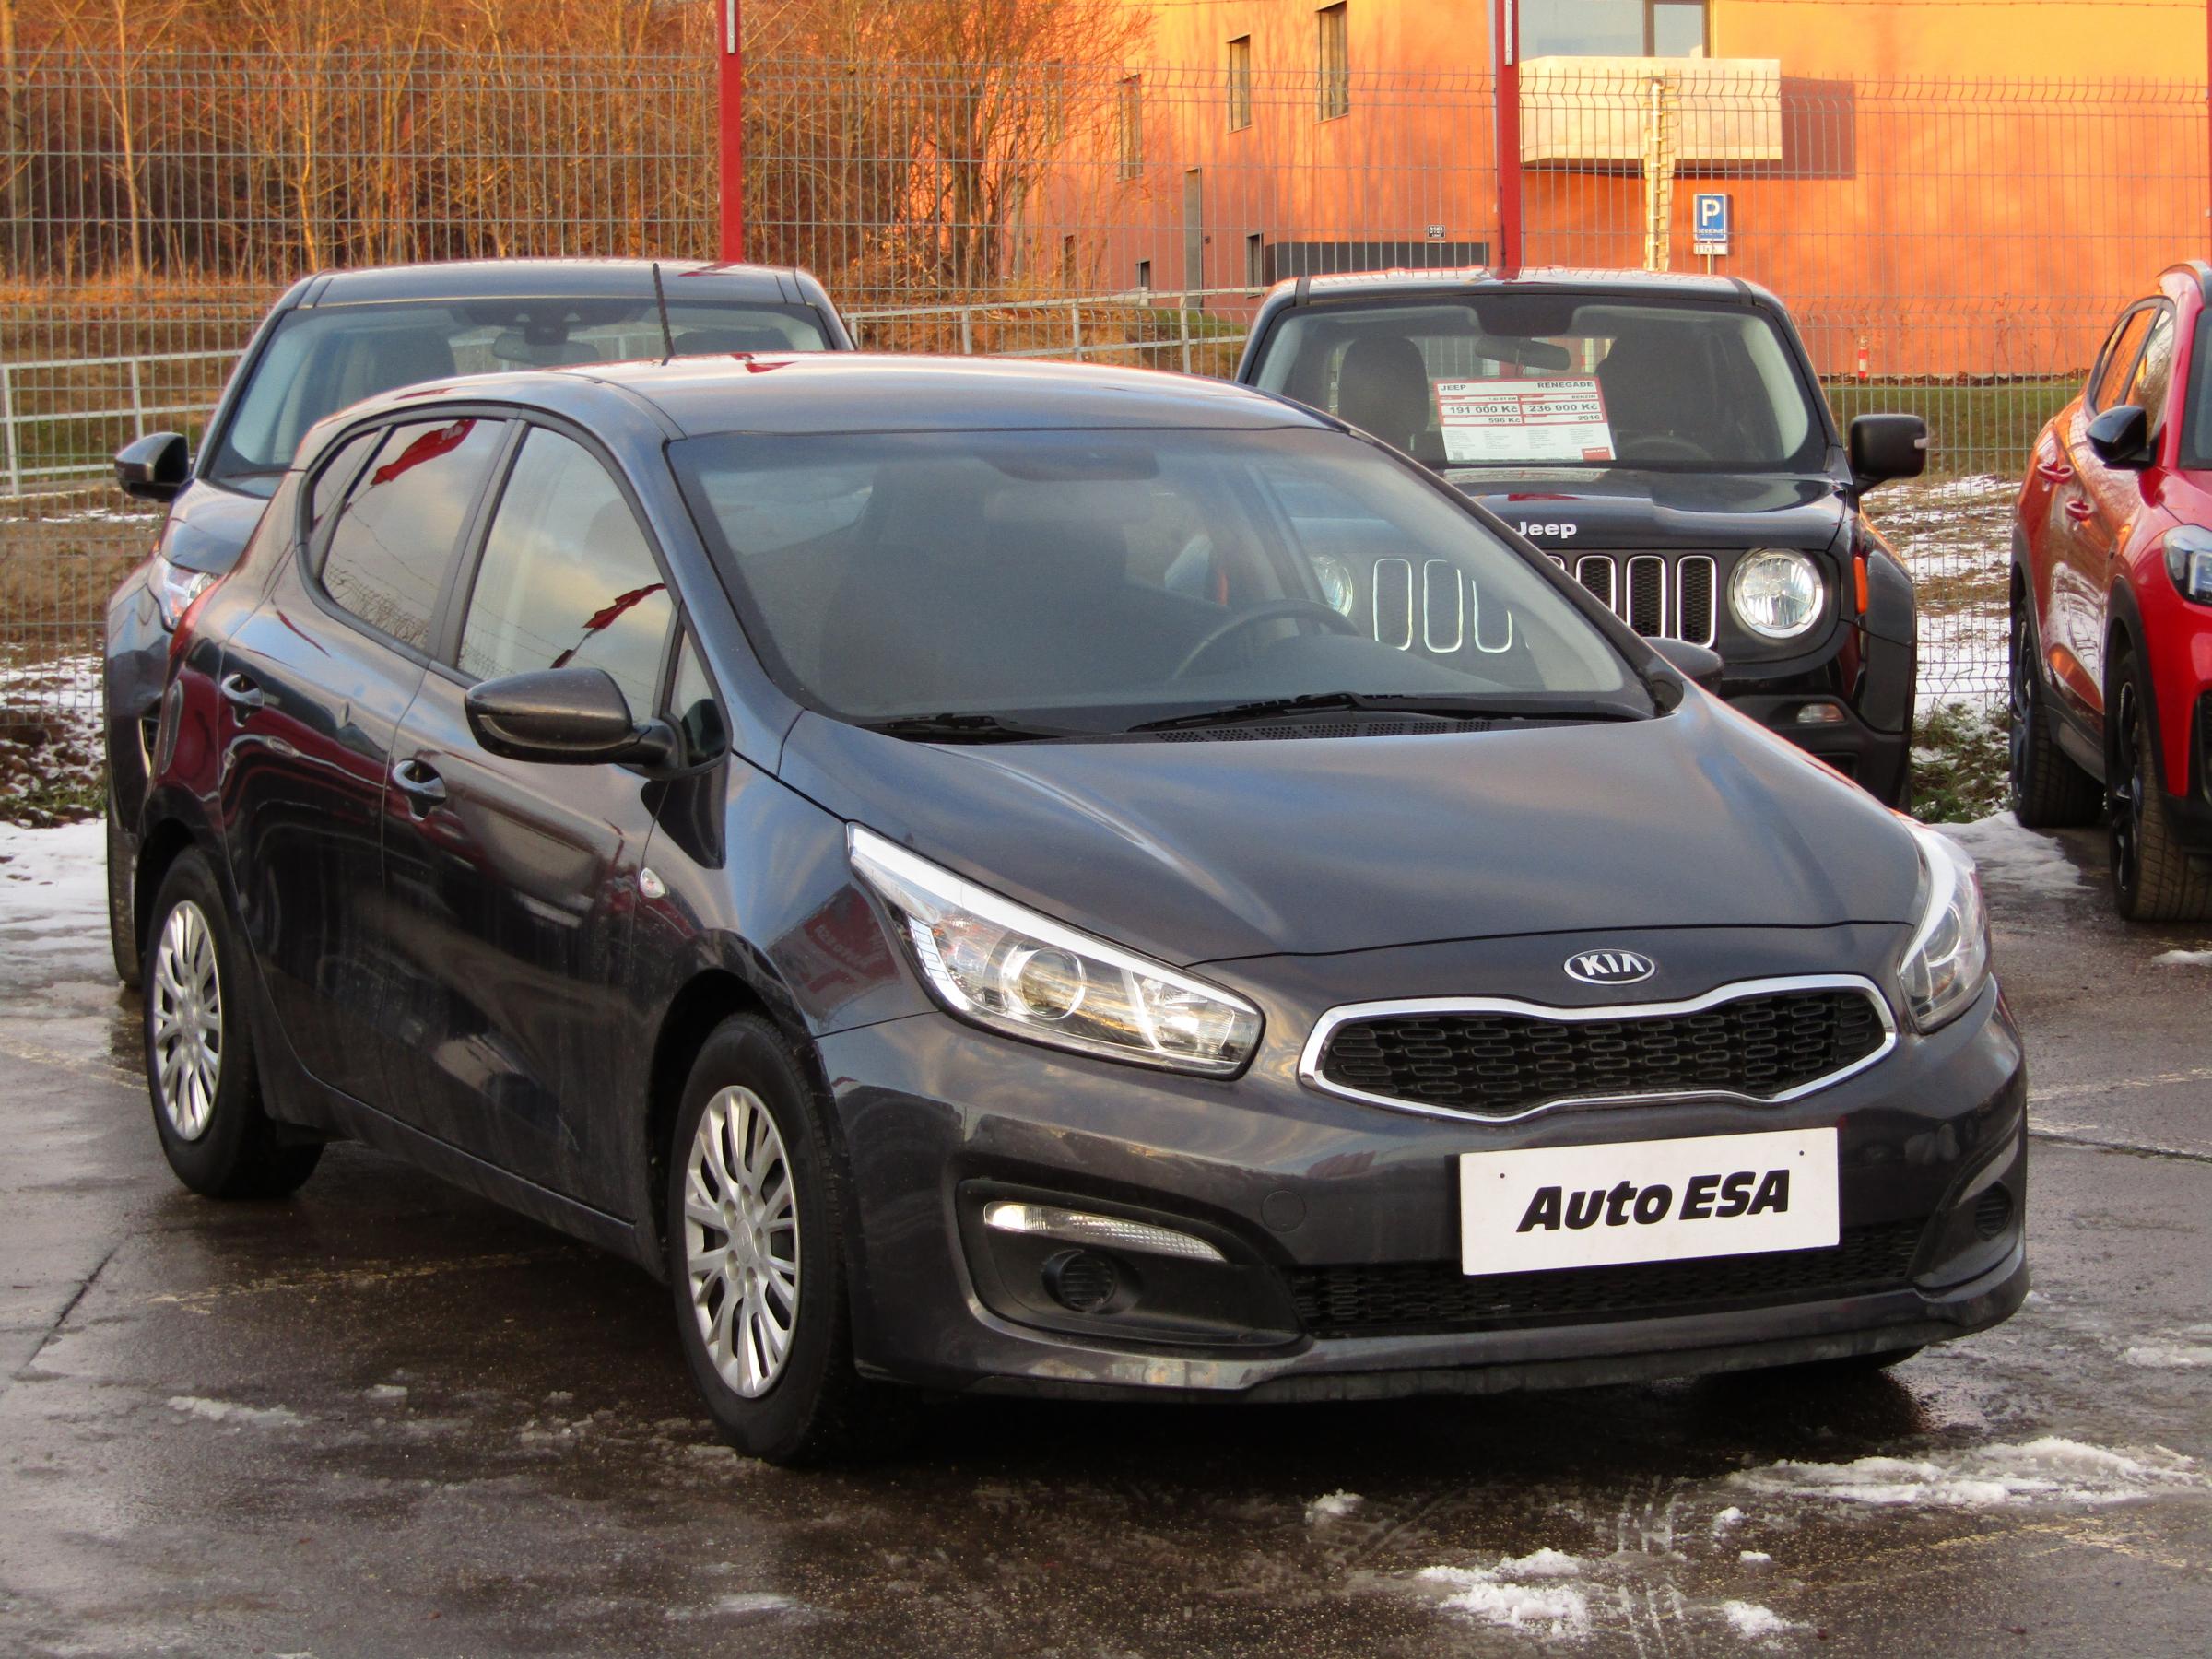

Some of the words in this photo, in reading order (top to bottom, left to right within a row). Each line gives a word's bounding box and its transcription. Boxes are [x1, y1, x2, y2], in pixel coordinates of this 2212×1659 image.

[1701, 198, 1721, 227] P
[1582, 402, 1598, 410] Kč
[1515, 521, 1577, 539] Jeep
[1577, 953, 1646, 976] KIA
[1516, 1181, 1673, 1233] Auto
[1678, 1169, 1790, 1220] ESA
